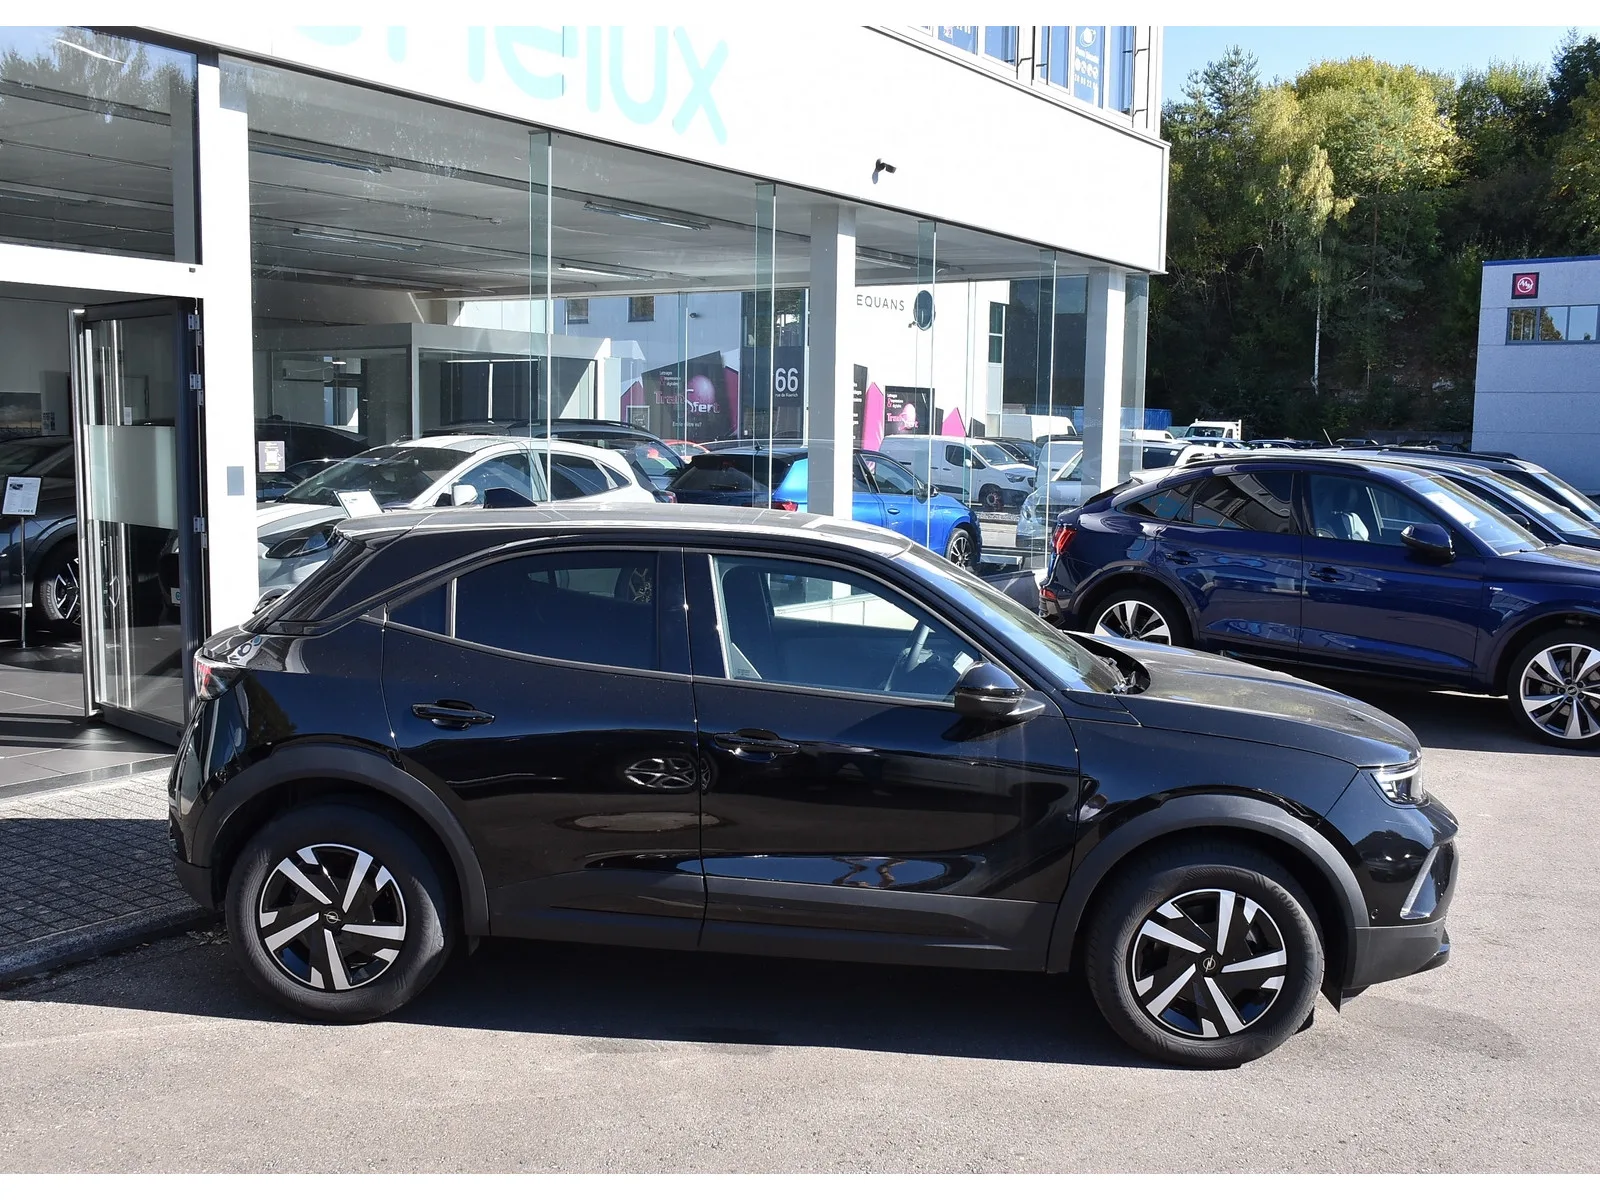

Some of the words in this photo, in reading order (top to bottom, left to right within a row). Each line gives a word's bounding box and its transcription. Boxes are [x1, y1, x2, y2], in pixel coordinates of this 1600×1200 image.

[295, 26, 729, 145] elux
[856, 294, 905, 311] EQUANS
[775, 367, 799, 392] 66
